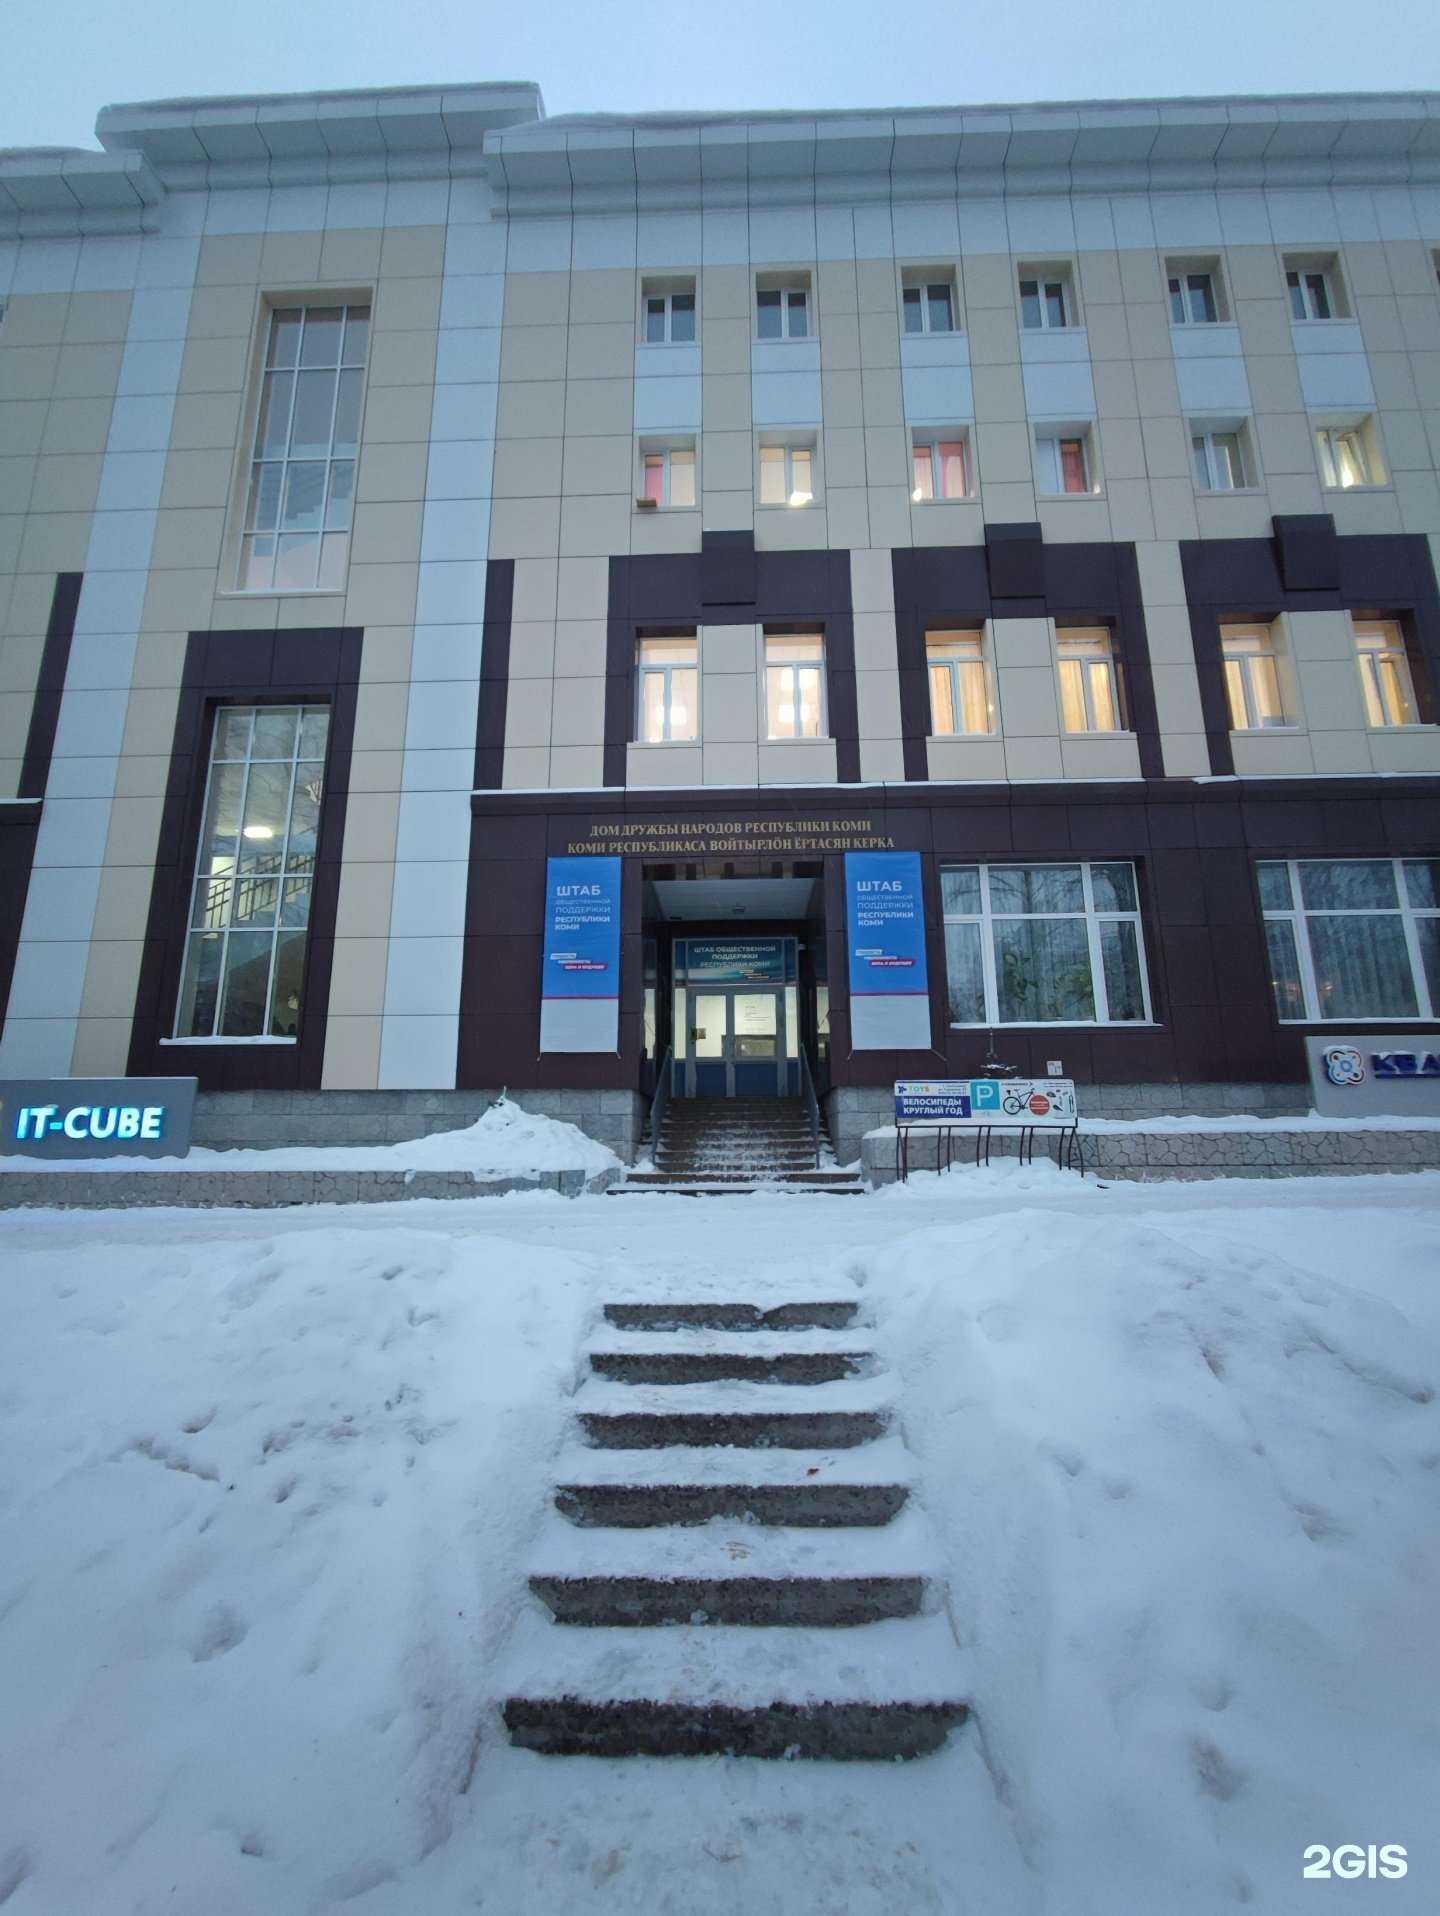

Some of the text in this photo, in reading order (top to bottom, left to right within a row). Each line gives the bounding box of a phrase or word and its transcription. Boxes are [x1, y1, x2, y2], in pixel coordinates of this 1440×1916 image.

[590, 820, 872, 837] ДОМ ДРУЖБЫ НАРОДОВ РЕСПУБЛИКИ КОМИ
[568, 842, 605, 854] КОМИ
[608, 840, 706, 853] РЕСПУБЛИКАСА
[853, 837, 895, 849] КЕРКА
[556, 885, 601, 896] ШТАБ
[856, 880, 903, 892] ШТАБ
[555, 906, 611, 914] ПОДДЕРЖКИ
[857, 902, 914, 910] ПОДДЕРЖКИ
[858, 911, 914, 919] РЕСПУБЛИКИ
[858, 919, 884, 927] КОМИ
[903, 1098, 962, 1106] ВЕЛОСИПЕДЫ
[903, 1106, 944, 1115] КРУГЛЫЙ
[16, 1106, 163, 1139] IT-CUBE
